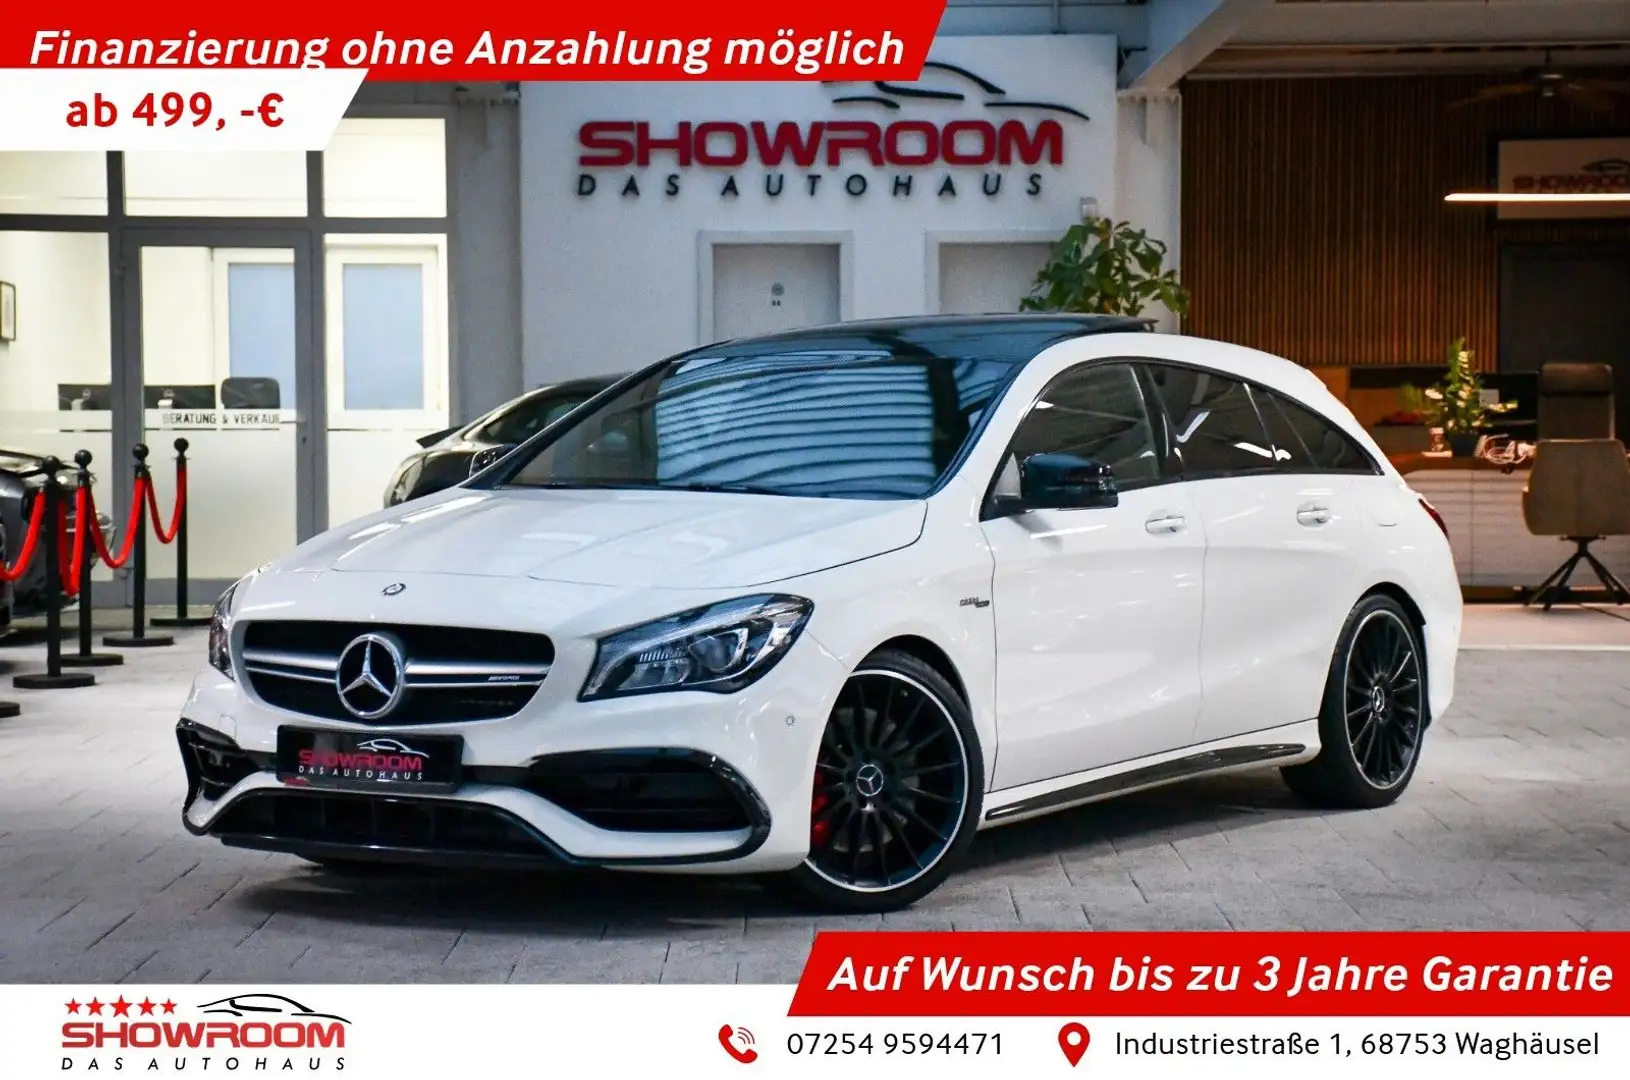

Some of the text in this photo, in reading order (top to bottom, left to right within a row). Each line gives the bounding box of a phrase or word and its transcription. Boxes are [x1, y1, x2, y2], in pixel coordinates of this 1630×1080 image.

[579, 120, 1064, 166] SHOWROOM
[577, 173, 1042, 197] DAS AUTOHAUS
[162, 413, 216, 424] BERATUNG
[299, 749, 423, 771] SHOWROOM
[298, 765, 423, 781] DAS AUTOHAUS
